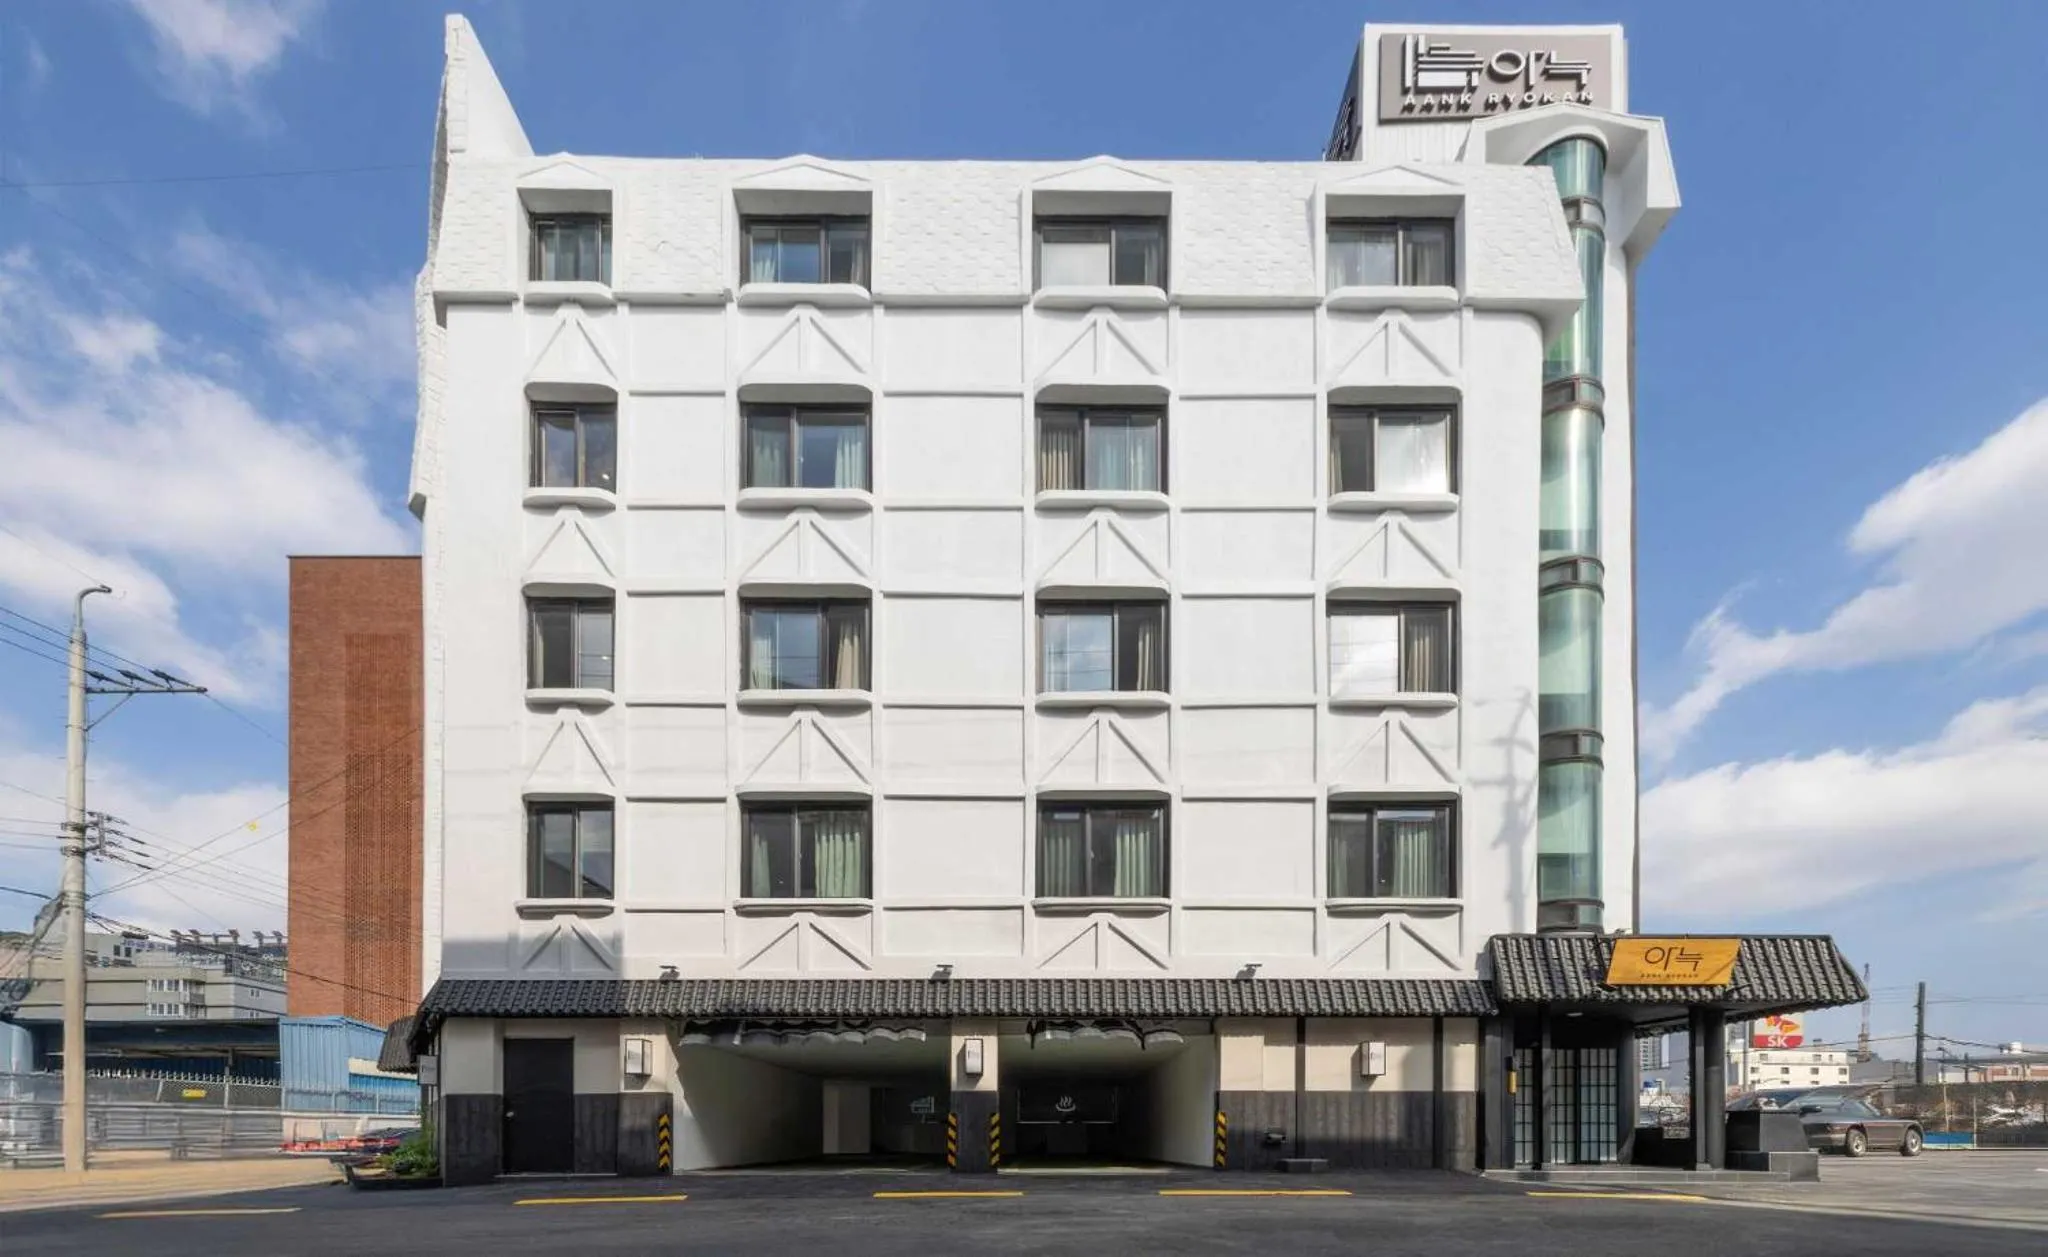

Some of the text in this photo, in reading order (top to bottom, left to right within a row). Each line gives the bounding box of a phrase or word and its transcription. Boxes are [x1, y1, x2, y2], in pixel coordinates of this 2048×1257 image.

[1404, 91, 1594, 104] AANK RYOKAN
[1767, 1035, 1788, 1047] SK
